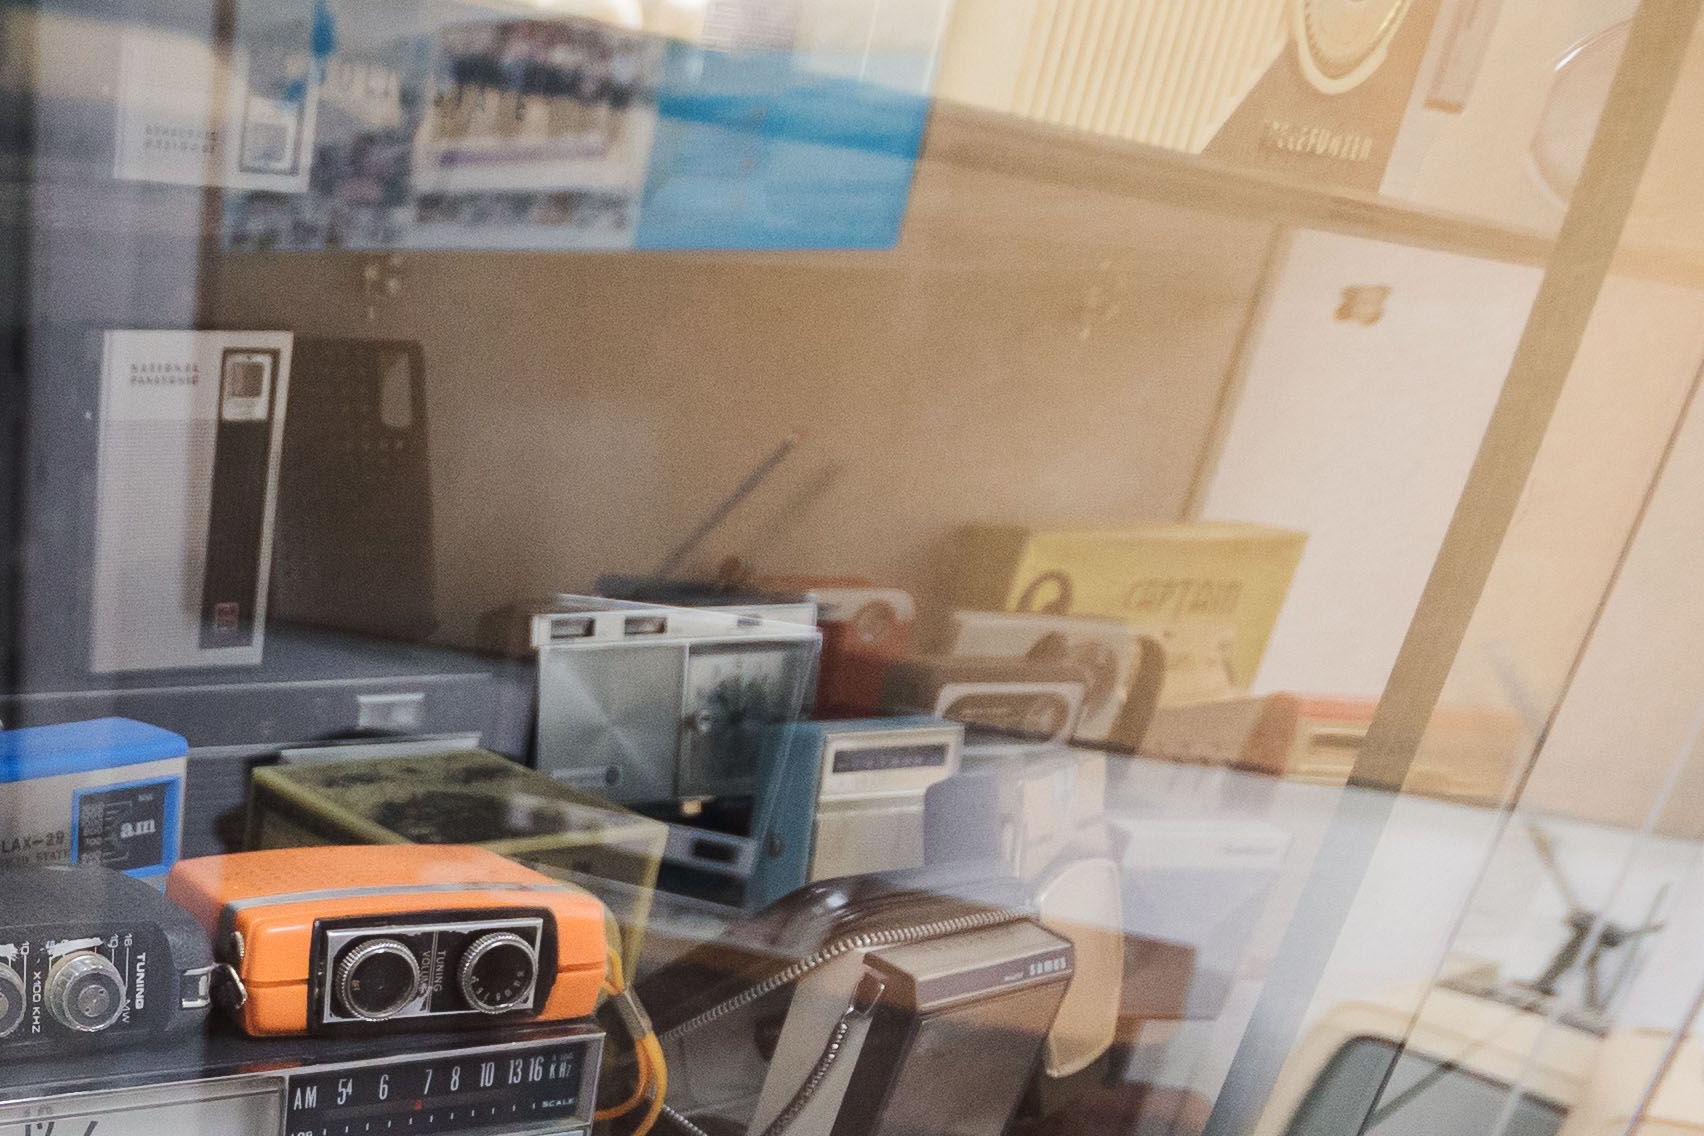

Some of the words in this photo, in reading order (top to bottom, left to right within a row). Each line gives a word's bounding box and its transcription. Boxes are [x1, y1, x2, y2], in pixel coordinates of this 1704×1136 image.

[119, 819, 156, 839] am
[135, 952, 147, 1010] TUNING
[433, 950, 447, 993] TUNING
[293, 1085, 318, 1111] AM
[379, 1074, 389, 1100] 6
[423, 1069, 433, 1095] 7
[450, 1065, 461, 1091] 8
[480, 1061, 495, 1088] 10
[508, 1058, 523, 1084] 13
[528, 1055, 544, 1081] 16
[541, 1097, 575, 1109] SCALE
